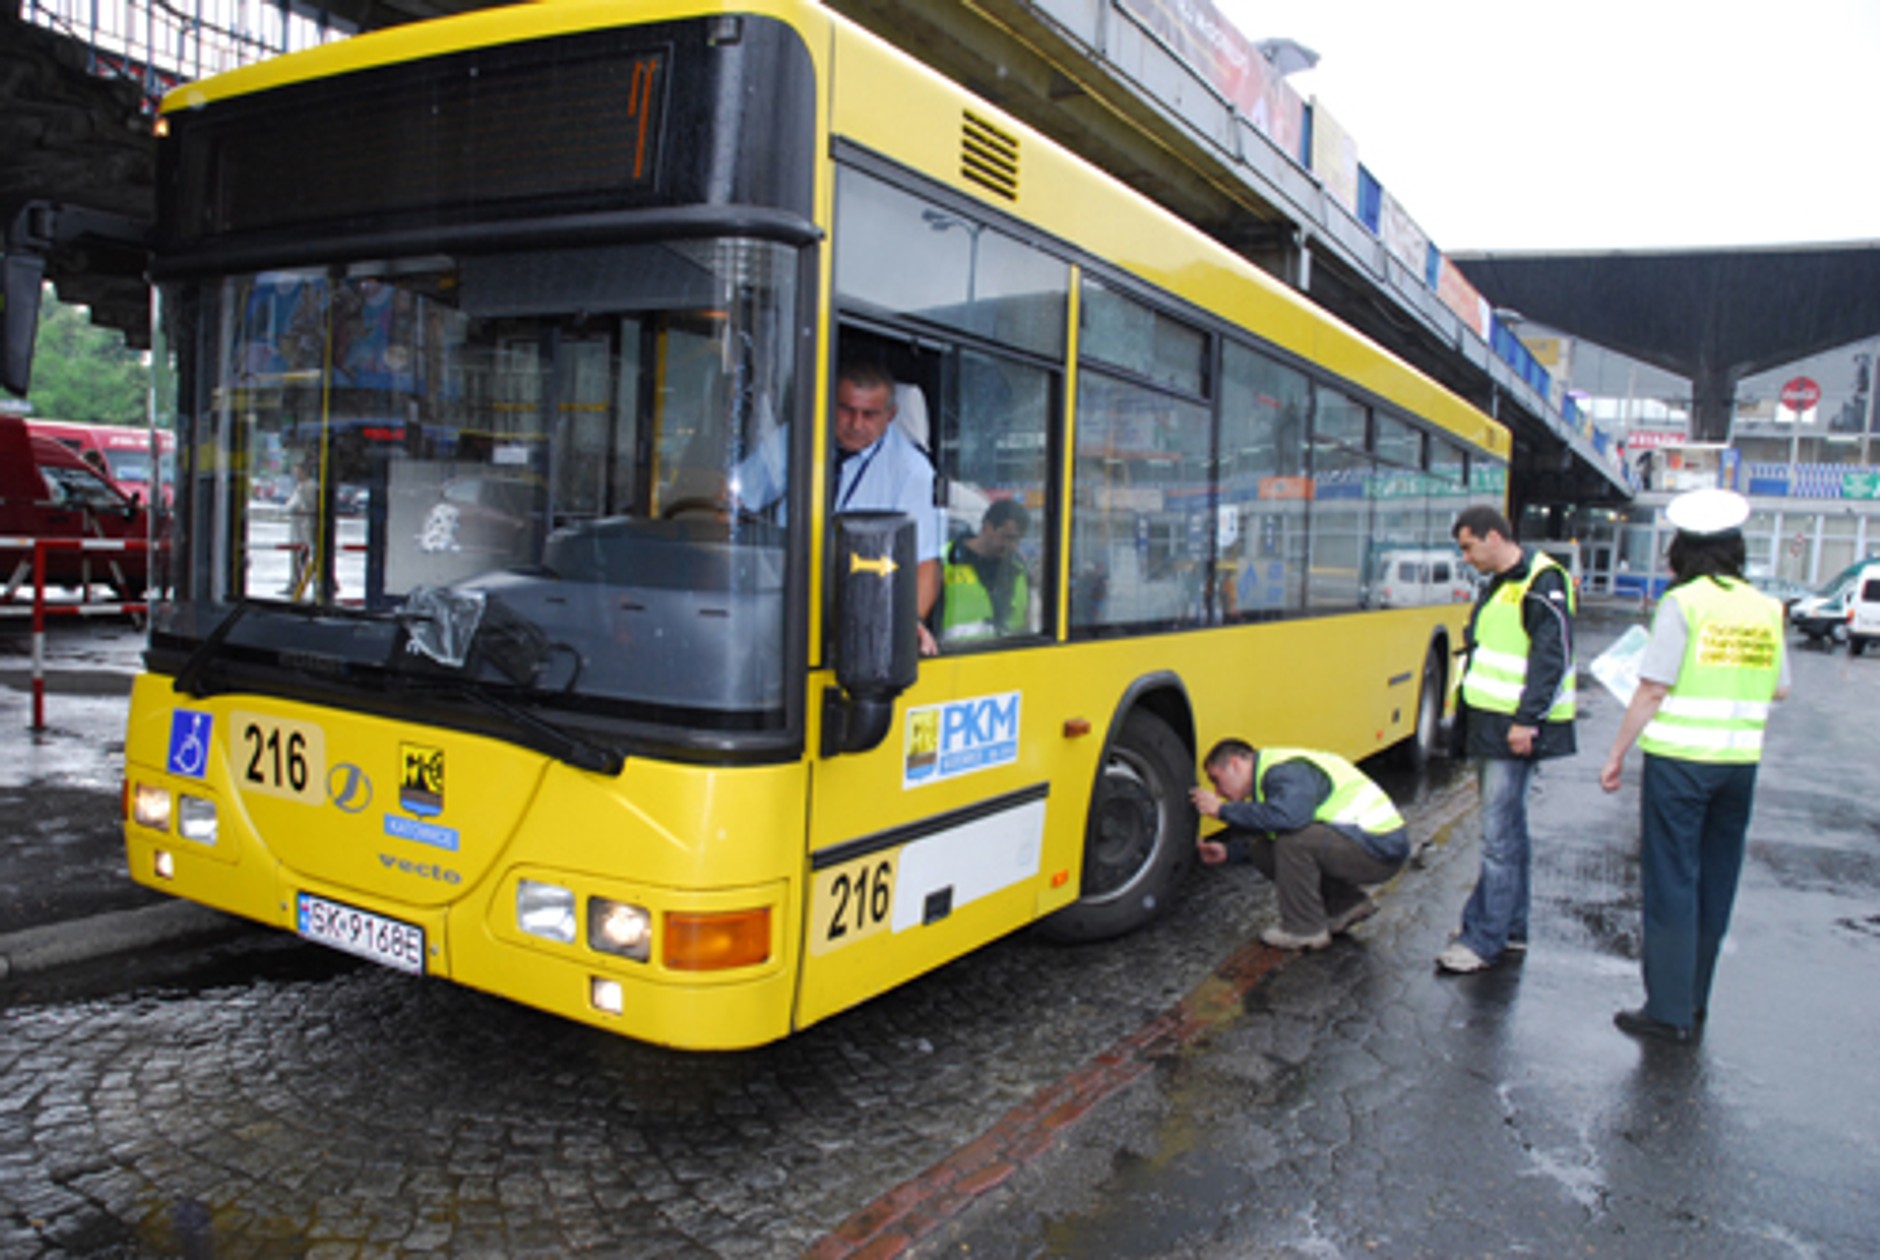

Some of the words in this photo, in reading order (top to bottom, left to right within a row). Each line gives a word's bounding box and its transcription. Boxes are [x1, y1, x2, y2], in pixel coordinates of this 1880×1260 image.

[942, 694, 1020, 752] PKM
[244, 722, 308, 793] 216
[378, 852, 462, 885] vecto
[827, 861, 892, 941] 216
